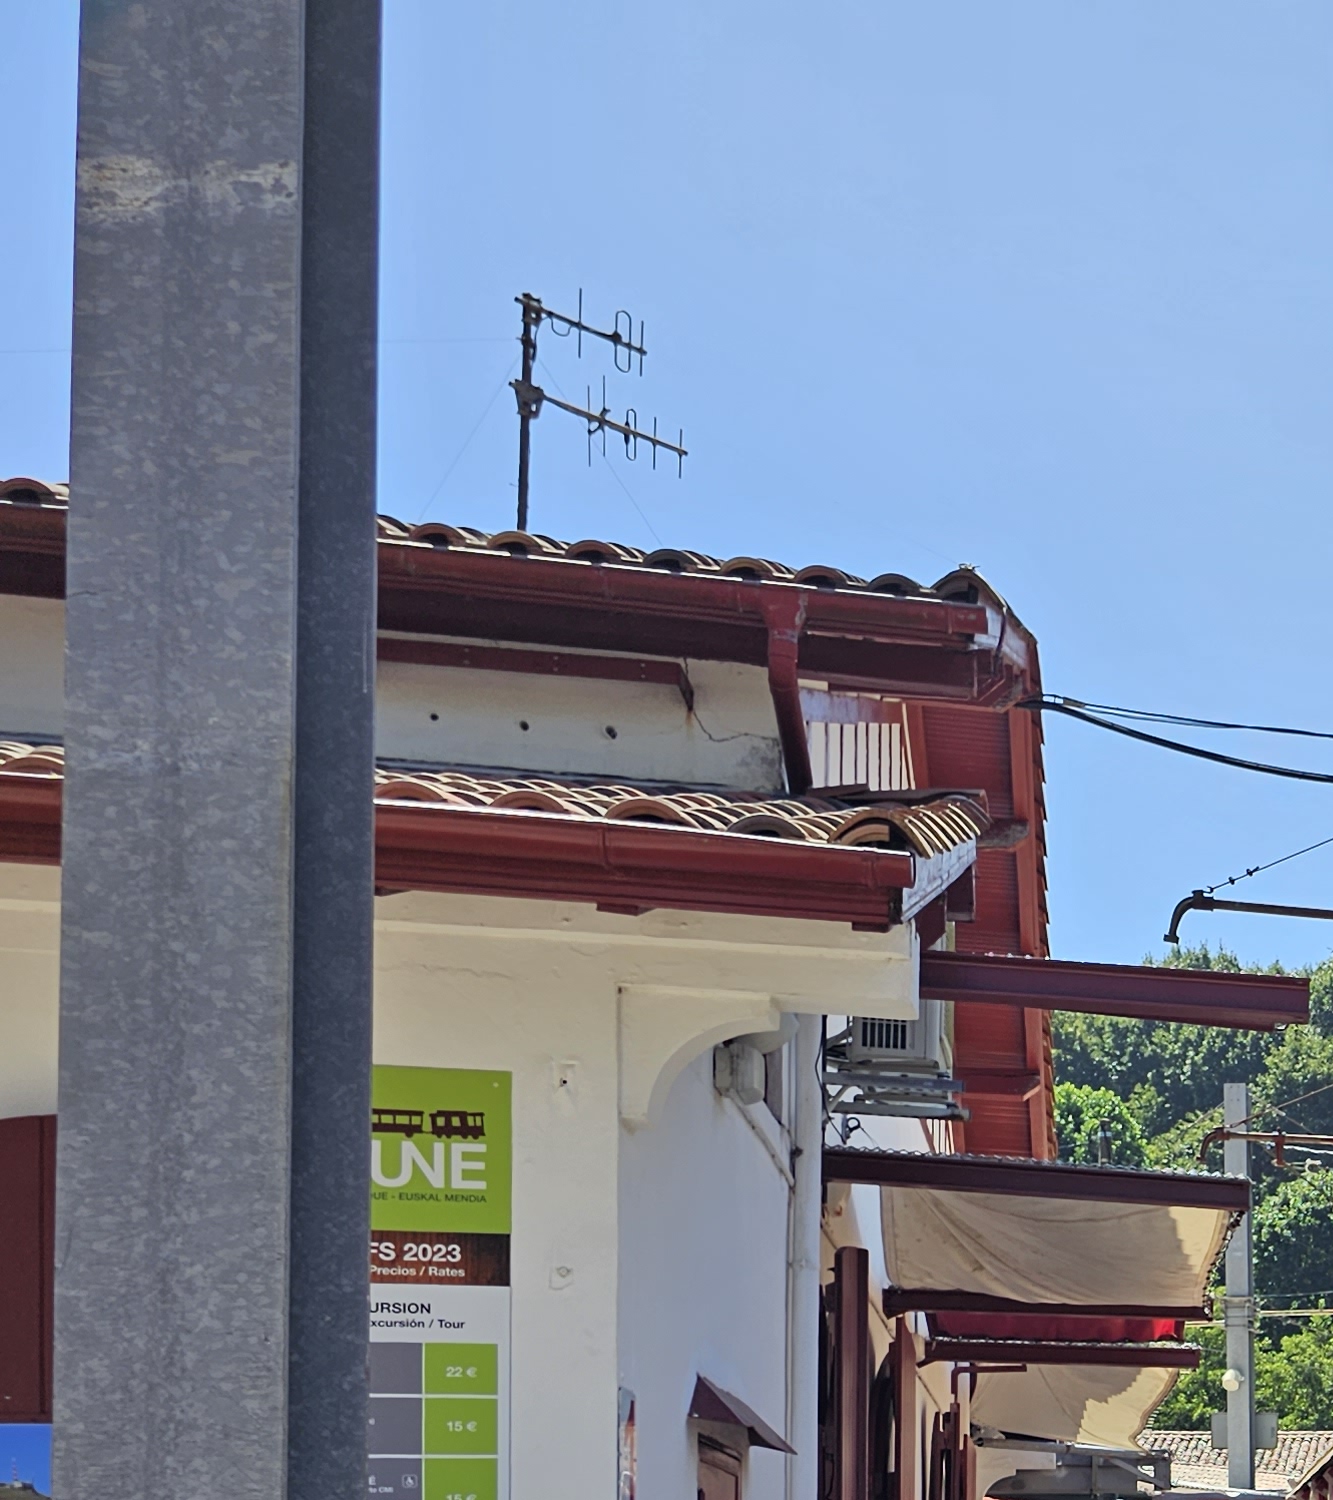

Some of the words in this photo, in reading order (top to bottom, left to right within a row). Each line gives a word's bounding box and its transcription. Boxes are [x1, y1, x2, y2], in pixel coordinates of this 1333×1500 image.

[371, 1140, 487, 1190] UNE
[371, 1192, 388, 1200] UE
[399, 1192, 442, 1201] EUSKAL
[445, 1194, 487, 1203] MENDIA
[403, 1243, 461, 1262] 2023
[371, 1265, 416, 1276] Precios
[428, 1266, 465, 1277] Rates
[438, 1319, 465, 1329] Tour
[446, 1367, 463, 1377] 22
[466, 1367, 477, 1378] €
[447, 1421, 463, 1432] 15
[466, 1421, 477, 1432] €
